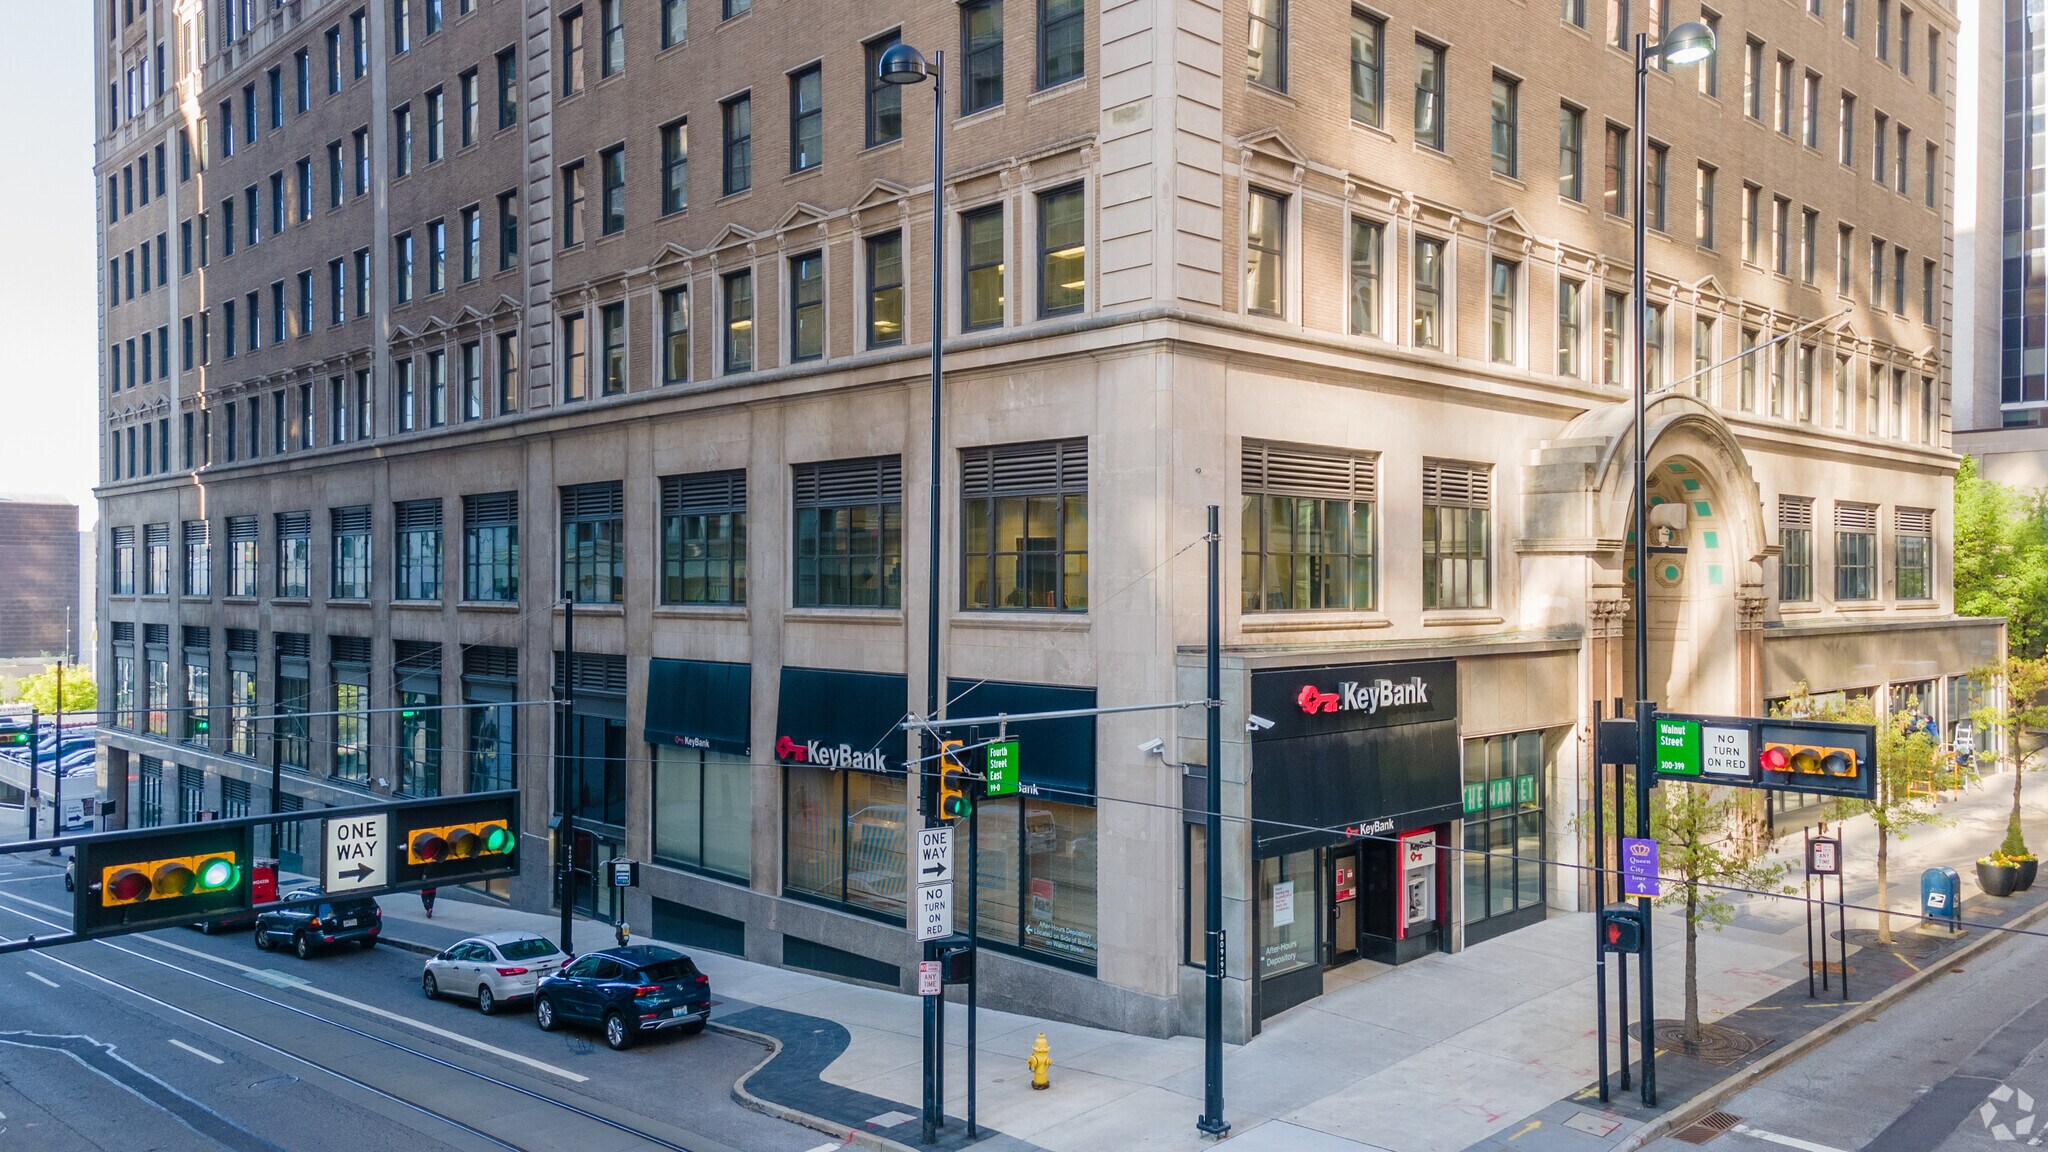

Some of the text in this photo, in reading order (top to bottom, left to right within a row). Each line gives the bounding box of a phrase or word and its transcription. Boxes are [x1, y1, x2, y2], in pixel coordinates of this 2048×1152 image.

[1343, 677, 1428, 714] KeyBank
[1660, 723, 1686, 735] Walnut
[684, 736, 710, 748] KeyBank
[1660, 736, 1684, 747] Street
[1717, 734, 1735, 744] NO
[807, 739, 887, 772] KeyBank
[990, 746, 1008, 757] Fourth
[1713, 746, 1740, 756] TURN
[990, 758, 1008, 769] Street
[1661, 760, 1685, 770] 300-399
[1707, 757, 1746, 769] ON RED
[990, 770, 1003, 781] East
[990, 783, 1001, 792] 99-0
[1490, 777, 1534, 806] MARET
[337, 821, 376, 841] ONE
[1360, 818, 1394, 836] KeyBank
[923, 832, 947, 846] ONE
[336, 840, 378, 861] WAY
[1410, 839, 1433, 852] KeyBank
[922, 846, 947, 861] WAY
[1629, 856, 1651, 865] Queen
[1630, 865, 1645, 874] City
[926, 888, 943, 901] NO
[924, 901, 946, 912] TURN
[928, 913, 941, 923] ON
[926, 924, 943, 935] RED
[1265, 941, 1297, 956] After-Hours
[1266, 952, 1297, 967] Depository
